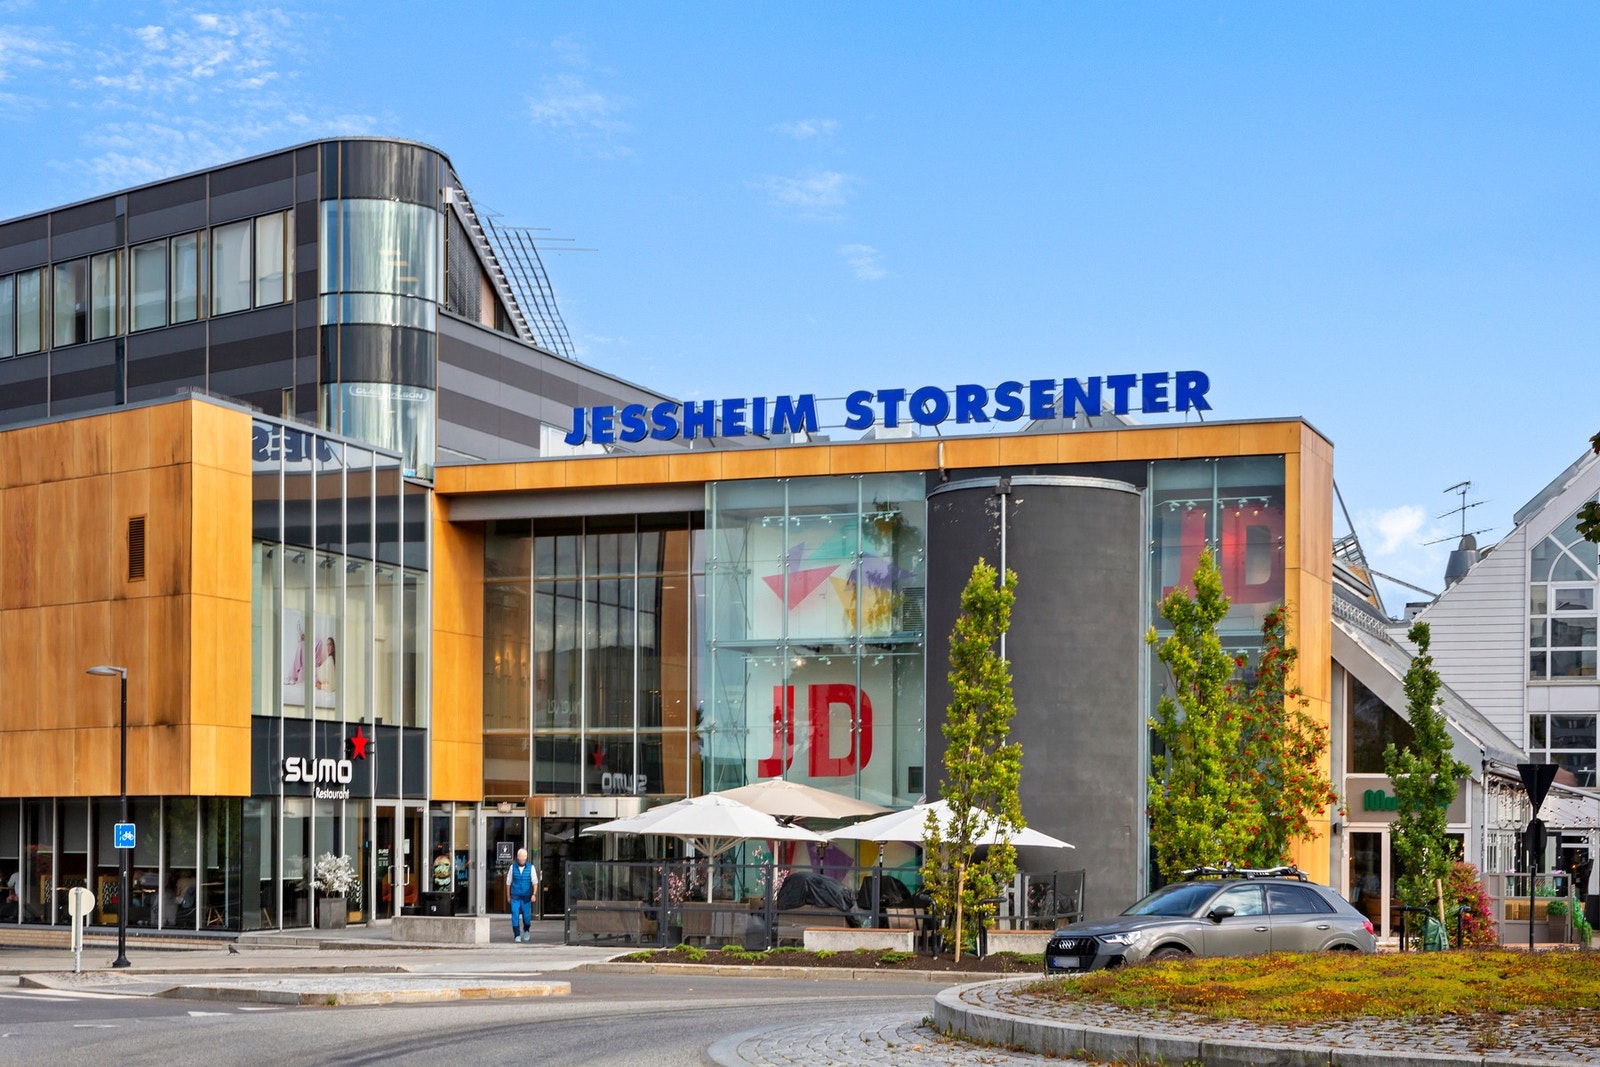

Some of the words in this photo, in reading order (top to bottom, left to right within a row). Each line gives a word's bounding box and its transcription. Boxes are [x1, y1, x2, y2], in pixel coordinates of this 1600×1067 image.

[564, 394, 820, 446] JESSHEIM
[844, 370, 1213, 430] STORSENTER
[757, 683, 873, 778] JD
[285, 756, 352, 783] SUMO
[315, 787, 350, 799] Restaurant
